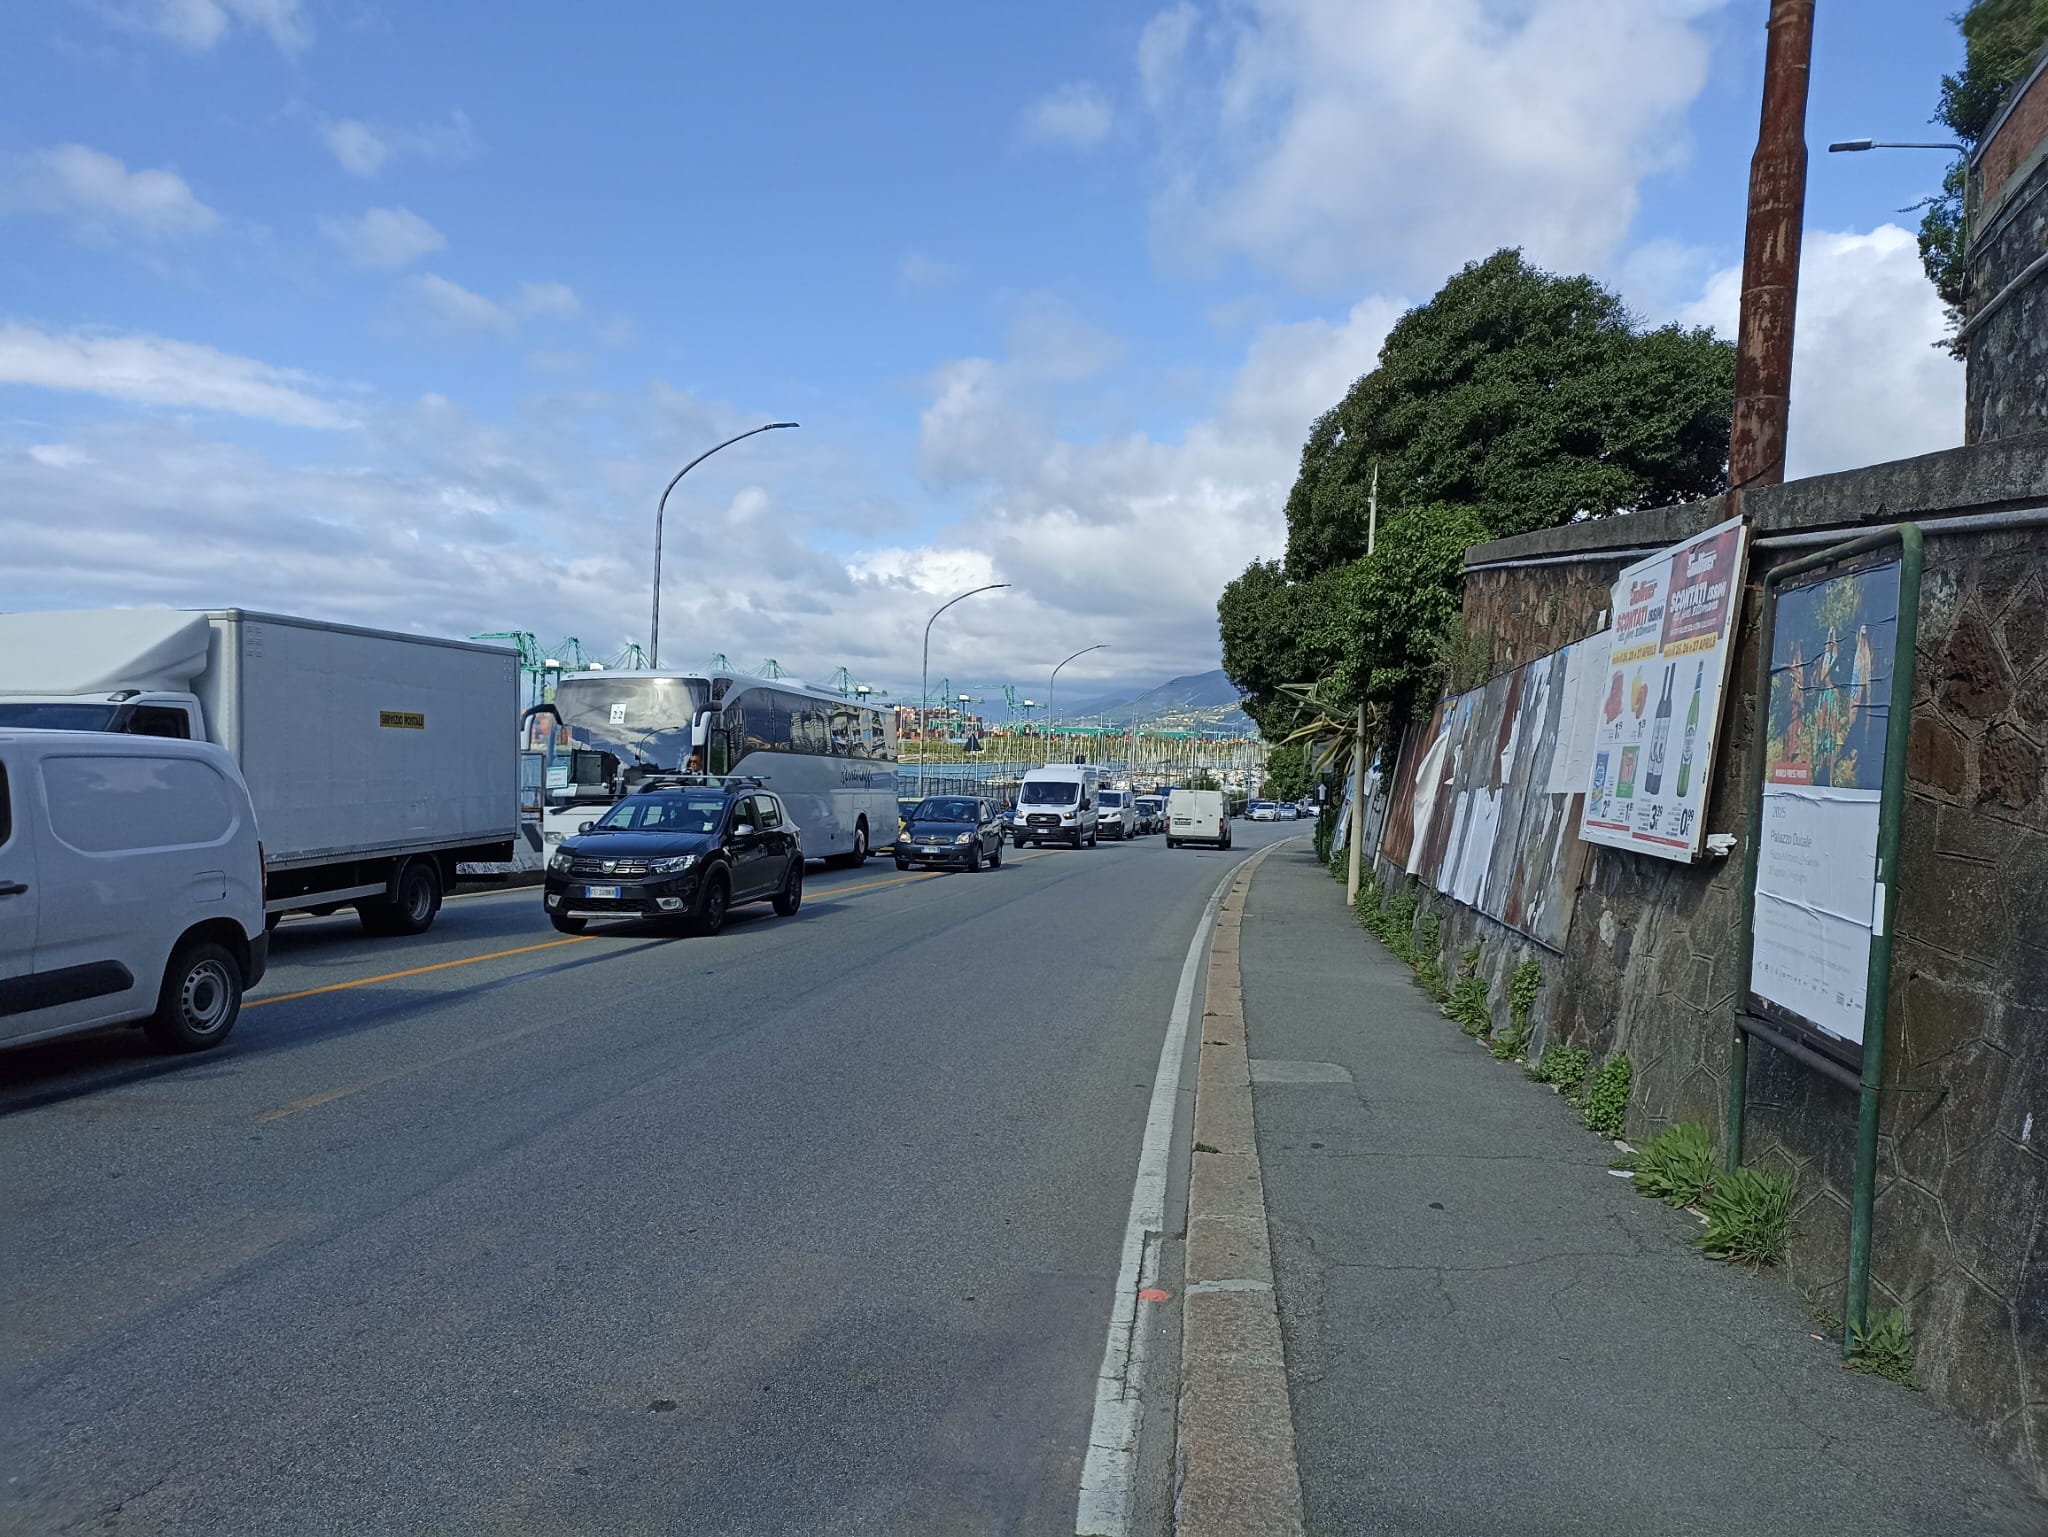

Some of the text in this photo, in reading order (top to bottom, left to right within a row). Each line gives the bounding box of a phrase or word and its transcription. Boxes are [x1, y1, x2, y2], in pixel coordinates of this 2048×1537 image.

[381, 713, 424, 726] SERVIZIO POSTALE
[1770, 829, 1812, 848] Palazzo Ducale
